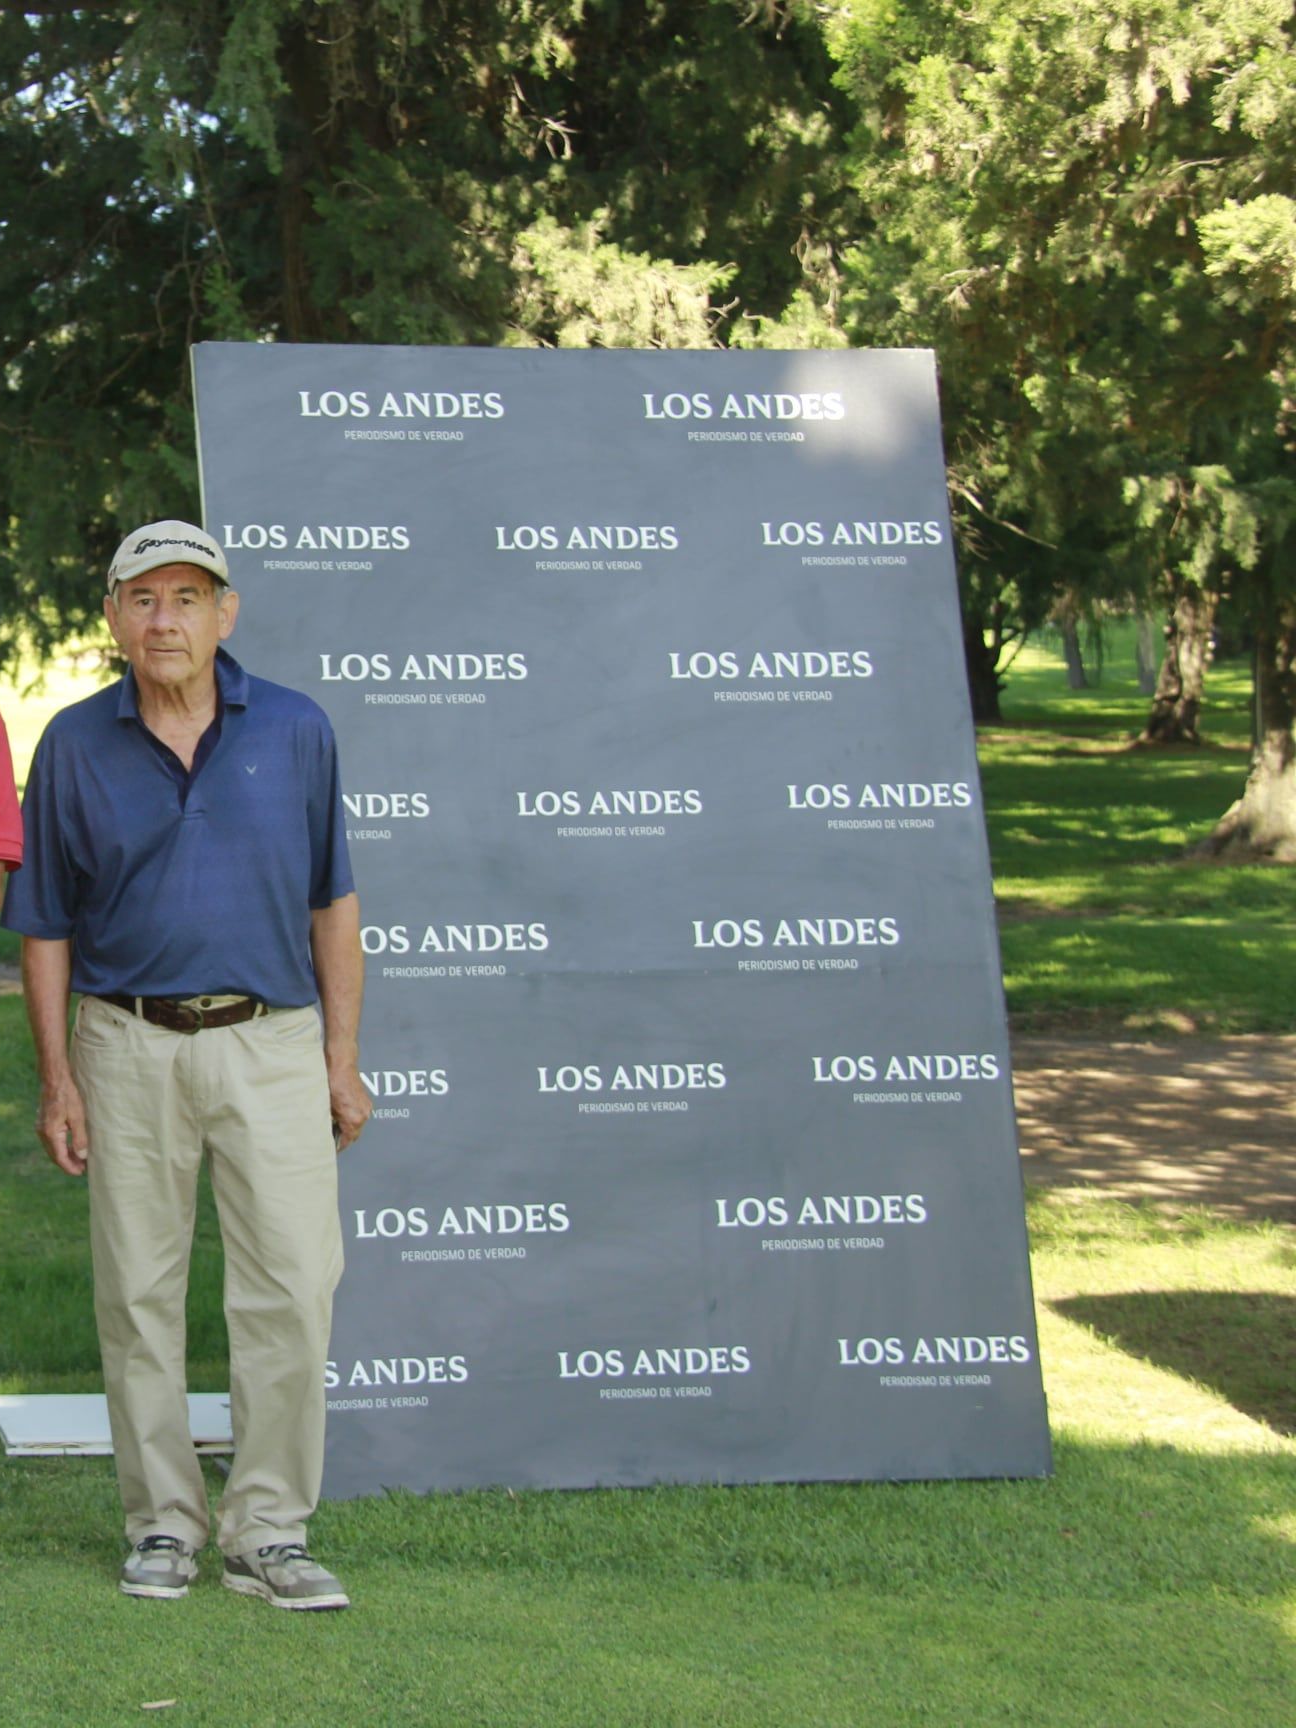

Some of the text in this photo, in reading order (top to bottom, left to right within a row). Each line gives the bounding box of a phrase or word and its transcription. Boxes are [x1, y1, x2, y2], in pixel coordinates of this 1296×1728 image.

[298, 390, 505, 419] LOS ANDES
[642, 392, 845, 421] LOS ANDES
[344, 430, 464, 441] PERIODISMO DE VERDAD
[687, 431, 806, 443] PERIODISMO DE VERDAD
[222, 524, 410, 550] LOS ANDES
[495, 525, 679, 550] LOS ANDES
[761, 520, 943, 546] LOS ANDES
[263, 560, 373, 571] PERIODISMO DE VERDAD
[535, 560, 642, 571] PERIODISMO DE VERDAD
[801, 555, 907, 566] PERIODISMO DE VERDAD
[319, 653, 528, 681] LOS ANDES
[668, 650, 874, 679] LOS ANDES
[364, 693, 486, 705] PERIODISMO DE VERDAD
[713, 690, 833, 702] PERIODISMO DE VERDAD
[342, 793, 429, 818] NDES
[516, 789, 703, 816] LOS ANDES
[787, 782, 972, 809] LOS ANDES
[354, 829, 391, 839] VERDAD
[556, 825, 666, 837] PERIODISMO DE VERDAD
[827, 818, 935, 830] PERIODISMO DE VERDAD
[360, 923, 548, 953] OS ANDES
[692, 917, 900, 948] LOS ANDES
[382, 964, 507, 978] PERIODISMO DE VERDAD
[737, 958, 859, 971] PERIODISMO DE VERDAD
[537, 1062, 727, 1092] LOS ANDES
[812, 1053, 1000, 1082] LOS ANDES
[359, 1069, 448, 1096] NDES
[578, 1100, 689, 1113] PERIODISMO DE VERDAD
[853, 1091, 962, 1103] PERIODISMO DE VERDAD
[372, 1108, 409, 1118] VERDAD
[354, 1202, 570, 1238] LOS ANDES
[715, 1194, 927, 1227] LOS ANDES
[401, 1246, 527, 1262] PERIODISMO DE VERDAD
[761, 1237, 885, 1251] PERIODISMO DE VERDAD
[838, 1335, 1030, 1365] LOS ANDES
[348, 1355, 468, 1386] ANDES
[557, 1345, 751, 1378] LOS ANDES
[879, 1374, 992, 1387] PERIODISMO DE VERDAD
[325, 1395, 429, 1411] RIODISMO DE VERDAD
[599, 1386, 712, 1400] PERIODISMO DE VERDAD
